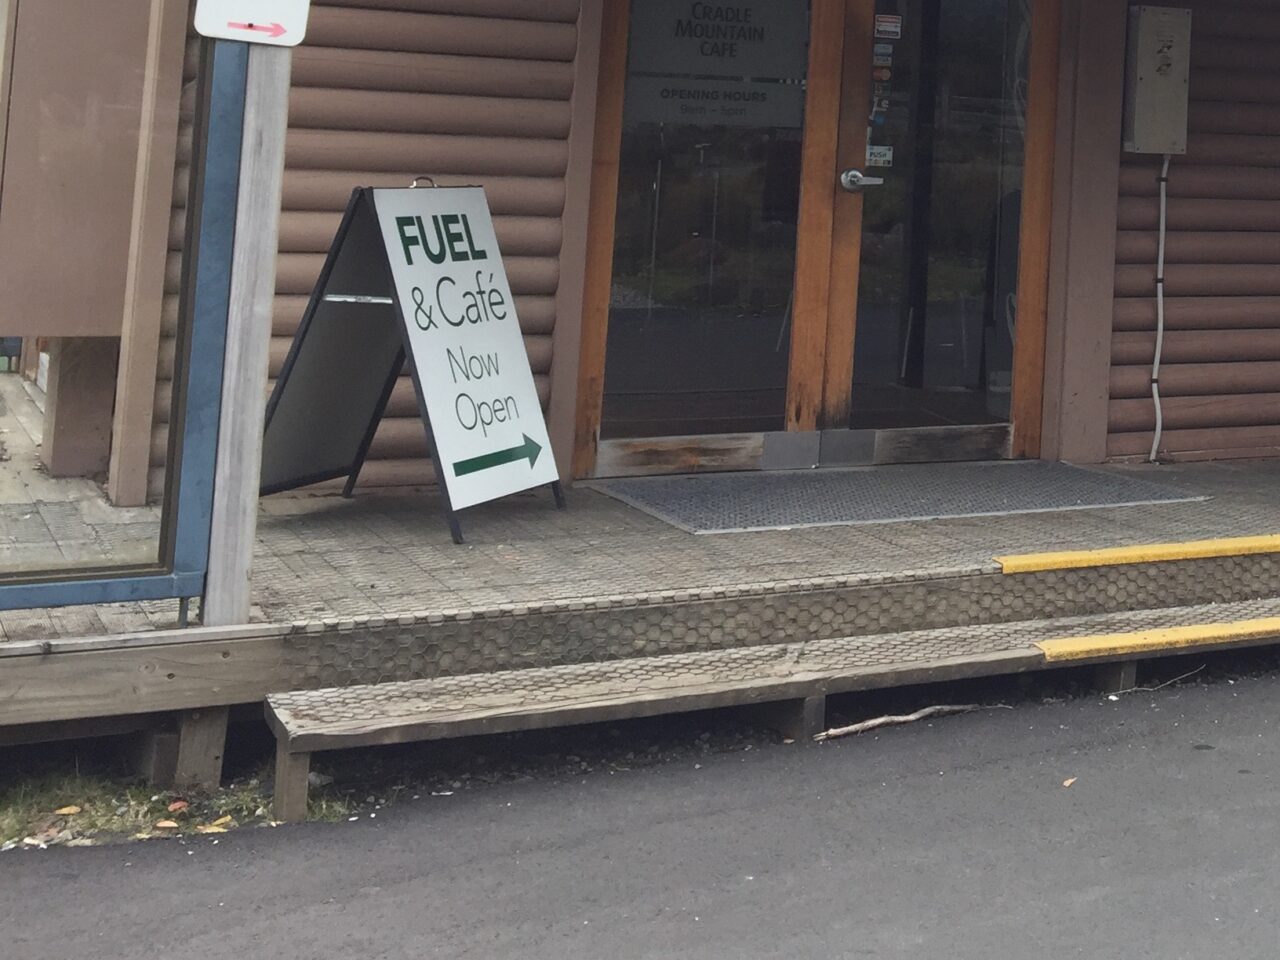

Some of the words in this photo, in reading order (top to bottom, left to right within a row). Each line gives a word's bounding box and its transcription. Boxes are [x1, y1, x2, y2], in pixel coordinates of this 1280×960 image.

[691, 2, 752, 23] CRADLE
[674, 19, 765, 41] MOUNTAIN
[700, 41, 737, 58] CAFE
[660, 89, 719, 101] OPENING
[723, 91, 768, 102] HOURS
[395, 214, 488, 265] FUEL
[435, 270, 507, 327] Café
[446, 346, 501, 384] Now
[455, 393, 520, 438] Open
